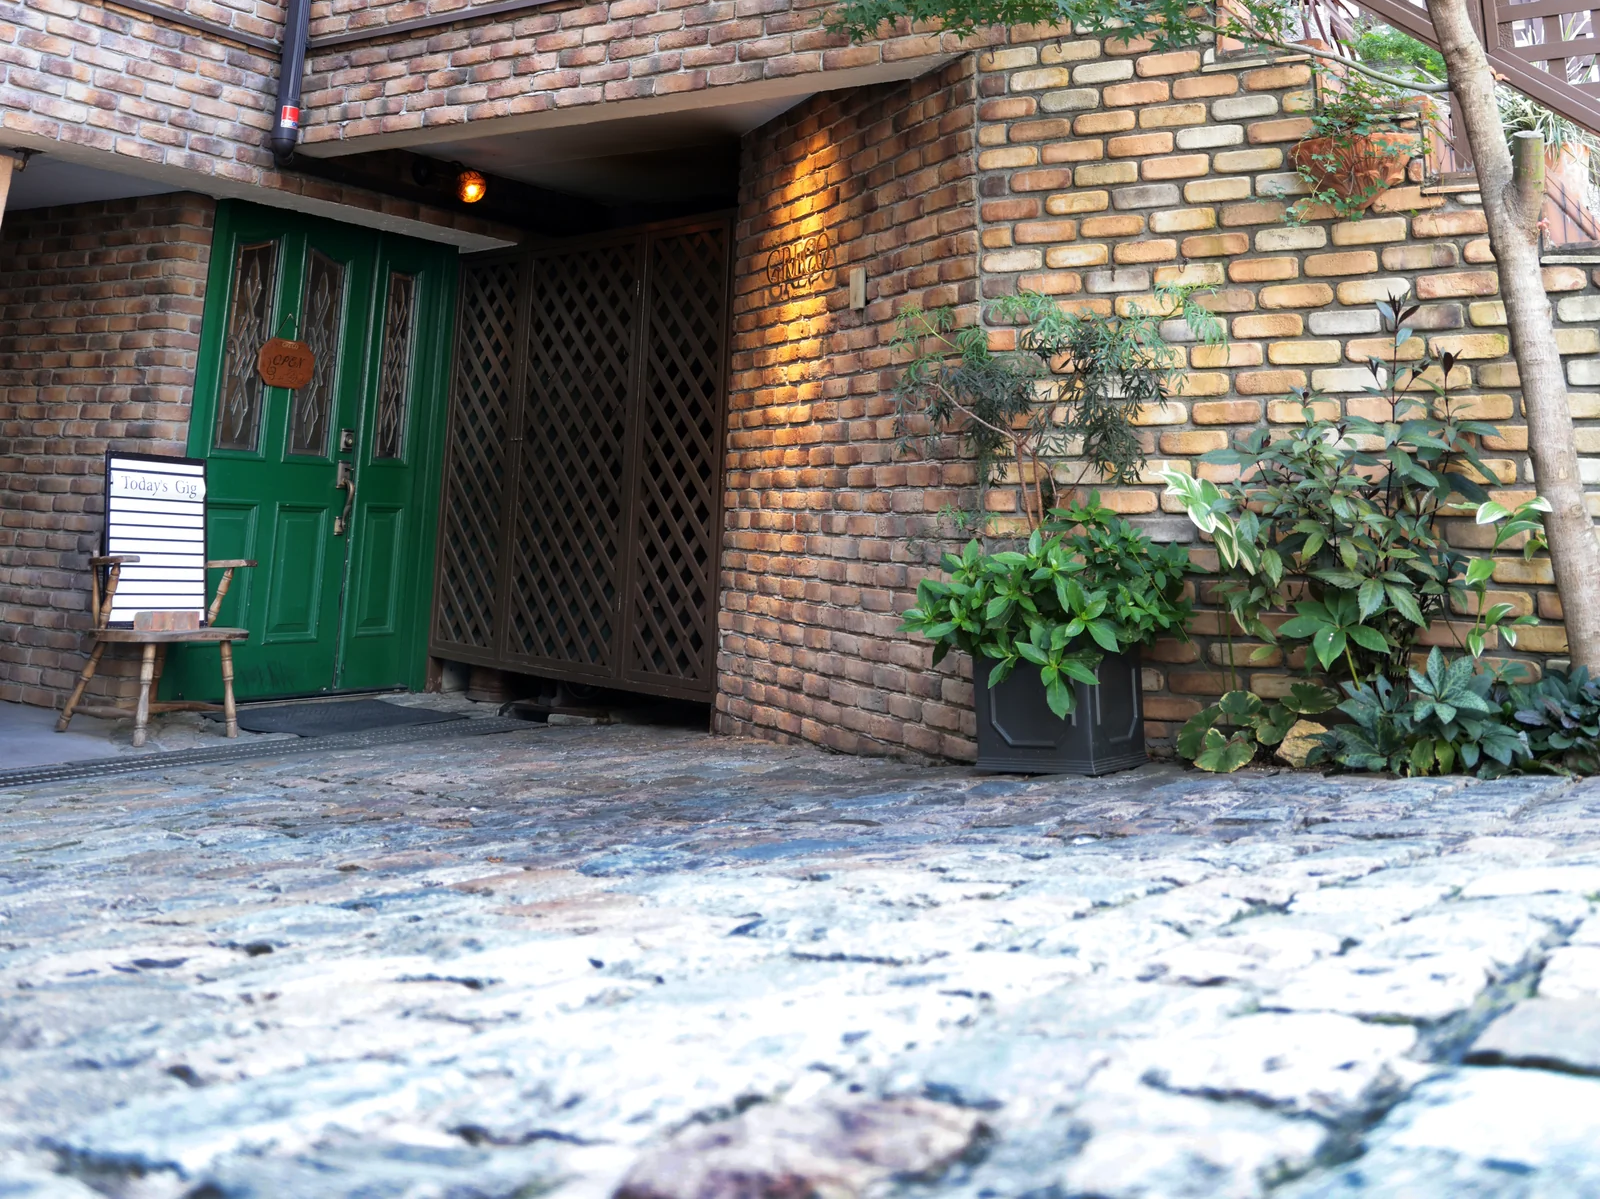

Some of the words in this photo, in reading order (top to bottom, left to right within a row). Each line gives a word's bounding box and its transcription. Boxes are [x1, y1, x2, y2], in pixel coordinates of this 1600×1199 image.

[273, 354, 305, 369] OPEN
[121, 475, 168, 496] Today's
[175, 480, 197, 499] Gig
